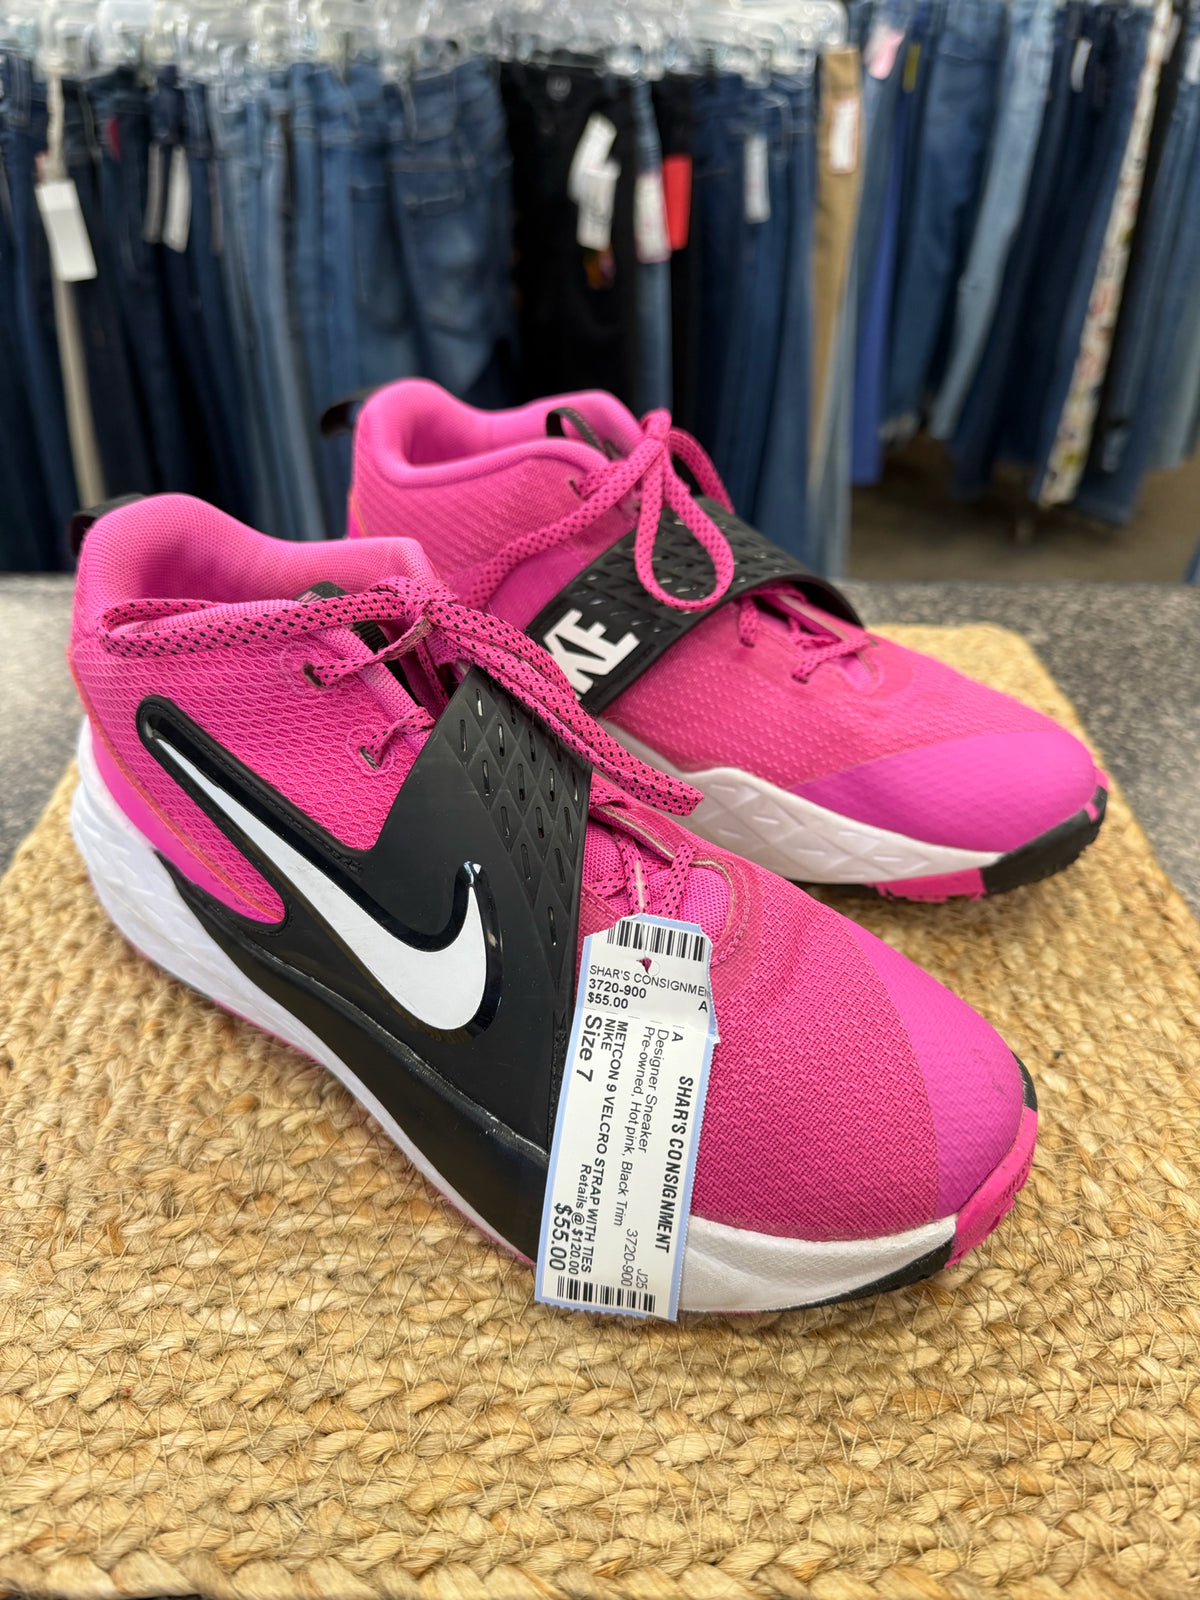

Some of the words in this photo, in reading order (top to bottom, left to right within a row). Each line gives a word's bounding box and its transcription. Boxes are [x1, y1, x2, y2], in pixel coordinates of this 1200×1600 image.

[588, 978, 647, 999] 3720-900
[589, 965, 631, 981] SHAR'S
[587, 991, 629, 1009] $55.00
[698, 1000, 708, 1013] A
[579, 1014, 603, 1061] Size
[600, 1018, 617, 1051] NIKE
[607, 1020, 629, 1081] METCON
[671, 1031, 684, 1043] A
[576, 1069, 594, 1082] 7
[630, 1026, 656, 1097] Pre-owned,
[647, 1029, 670, 1091] Designer
[606, 1083, 617, 1093] 9
[671, 1075, 694, 1135] SHAR'S
[596, 1096, 616, 1154] VELCRO
[628, 1101, 643, 1125] Hot
[638, 1094, 658, 1153] Sneaker
[621, 1125, 636, 1156] pink,
[575, 1163, 592, 1209] Retails
[590, 1157, 606, 1206] STRAP
[618, 1160, 633, 1196] Black
[655, 1138, 685, 1254] CONSIGNMENT
[571, 1212, 585, 1225] @
[584, 1208, 599, 1242] WITH
[613, 1200, 628, 1227] Trim
[549, 1202, 573, 1271] $55.00
[568, 1228, 584, 1276] $120.00
[581, 1246, 594, 1274] TIES
[621, 1228, 639, 1287] 3720-900
[635, 1268, 649, 1290] J25
